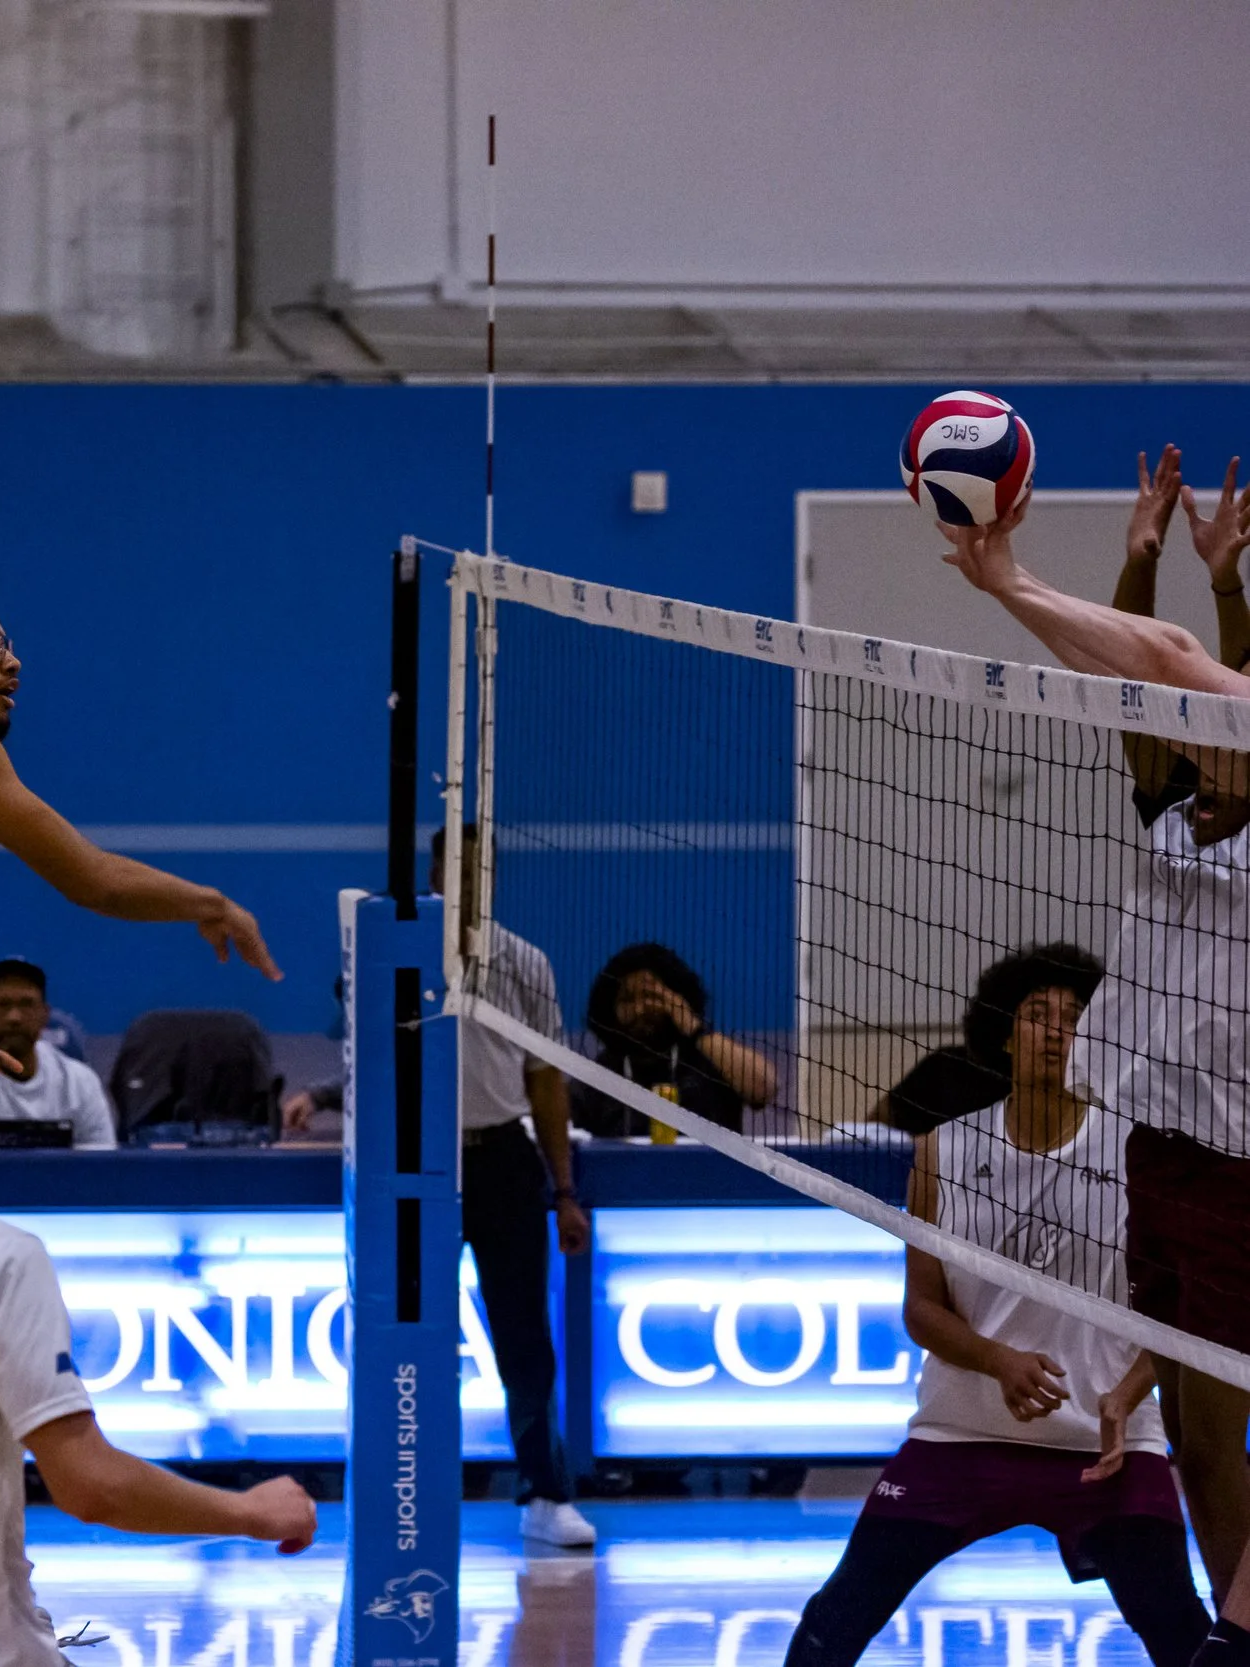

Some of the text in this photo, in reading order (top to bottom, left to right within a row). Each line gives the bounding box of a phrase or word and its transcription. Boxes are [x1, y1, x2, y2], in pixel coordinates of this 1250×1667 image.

[941, 424, 980, 442] SMC
[986, 662, 1005, 687] SMC
[1121, 683, 1144, 707] SMC
[617, 1279, 928, 1387] COL
[392, 1363, 419, 1551] sports imports
